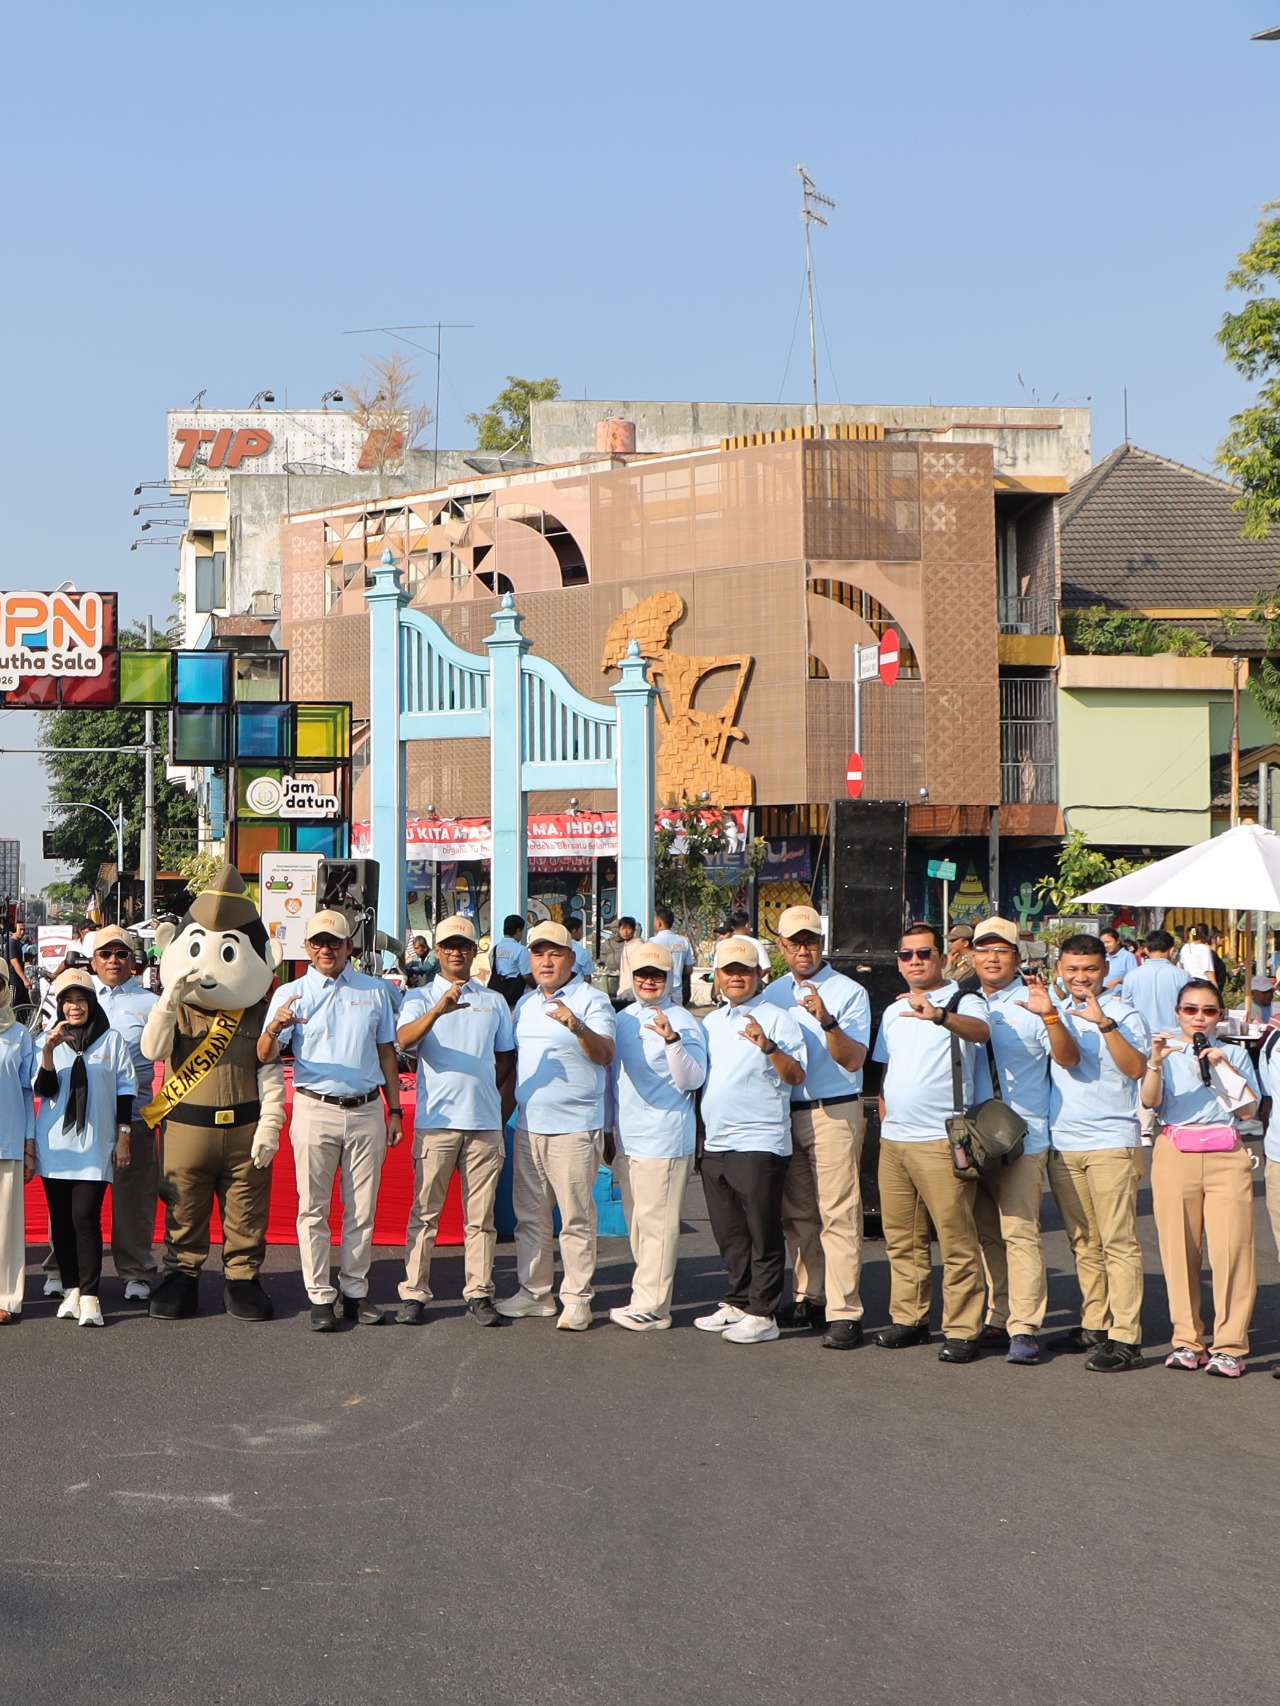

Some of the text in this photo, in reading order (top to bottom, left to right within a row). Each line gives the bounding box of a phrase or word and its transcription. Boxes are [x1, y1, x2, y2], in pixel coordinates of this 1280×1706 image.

[175, 428, 273, 469] TIP
[51, 652, 96, 670] Sala
[282, 780, 315, 797] jam
[285, 794, 335, 808] datun
[416, 827, 451, 840] KITA
[557, 841, 587, 850] Bersatu
[162, 1012, 238, 1106] KEJAKSAAN RI
